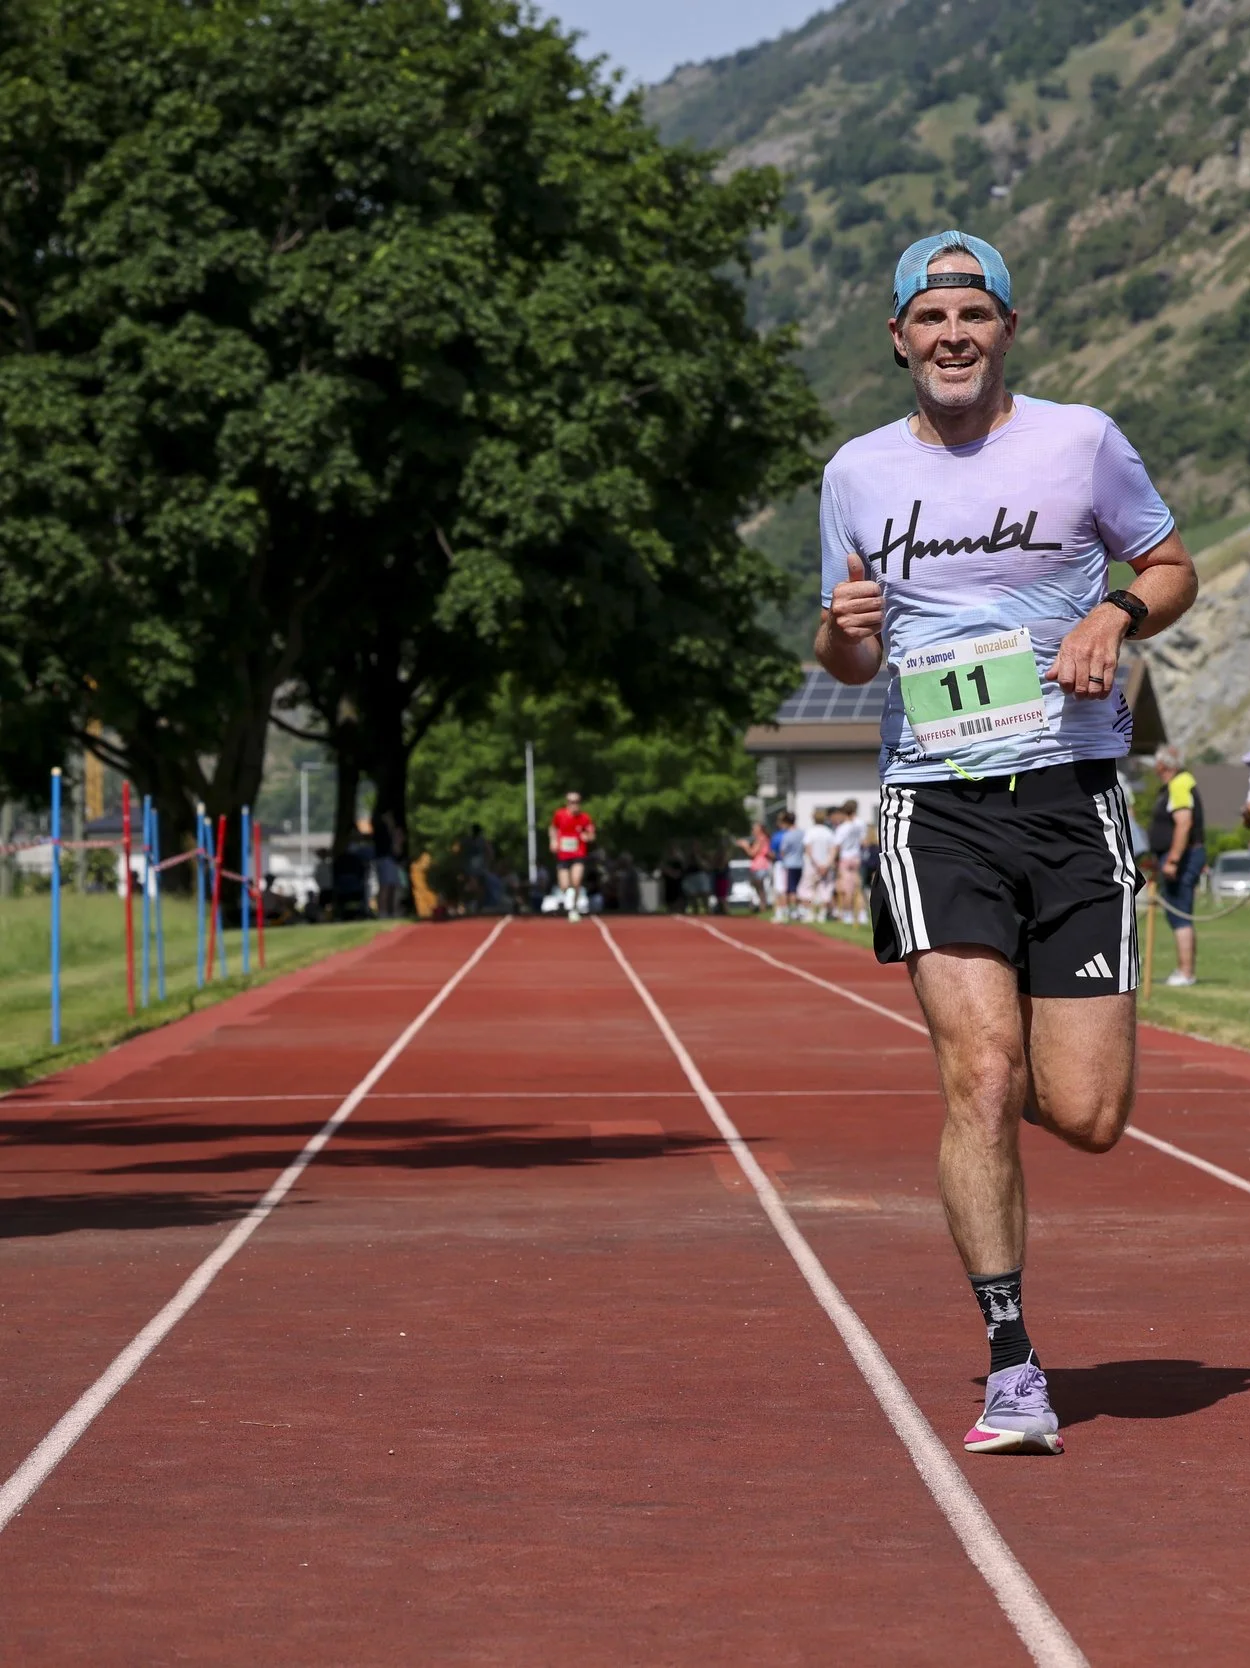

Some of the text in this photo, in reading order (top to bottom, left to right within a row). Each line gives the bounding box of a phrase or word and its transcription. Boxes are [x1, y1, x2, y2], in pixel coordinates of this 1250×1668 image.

[974, 635, 1019, 655] lonzalauf
[906, 649, 956, 668] stv gampel
[940, 665, 990, 711] 11
[994, 710, 1043, 727] RAIFFEISEN
[916, 728, 956, 742] RAIFFEISEN
